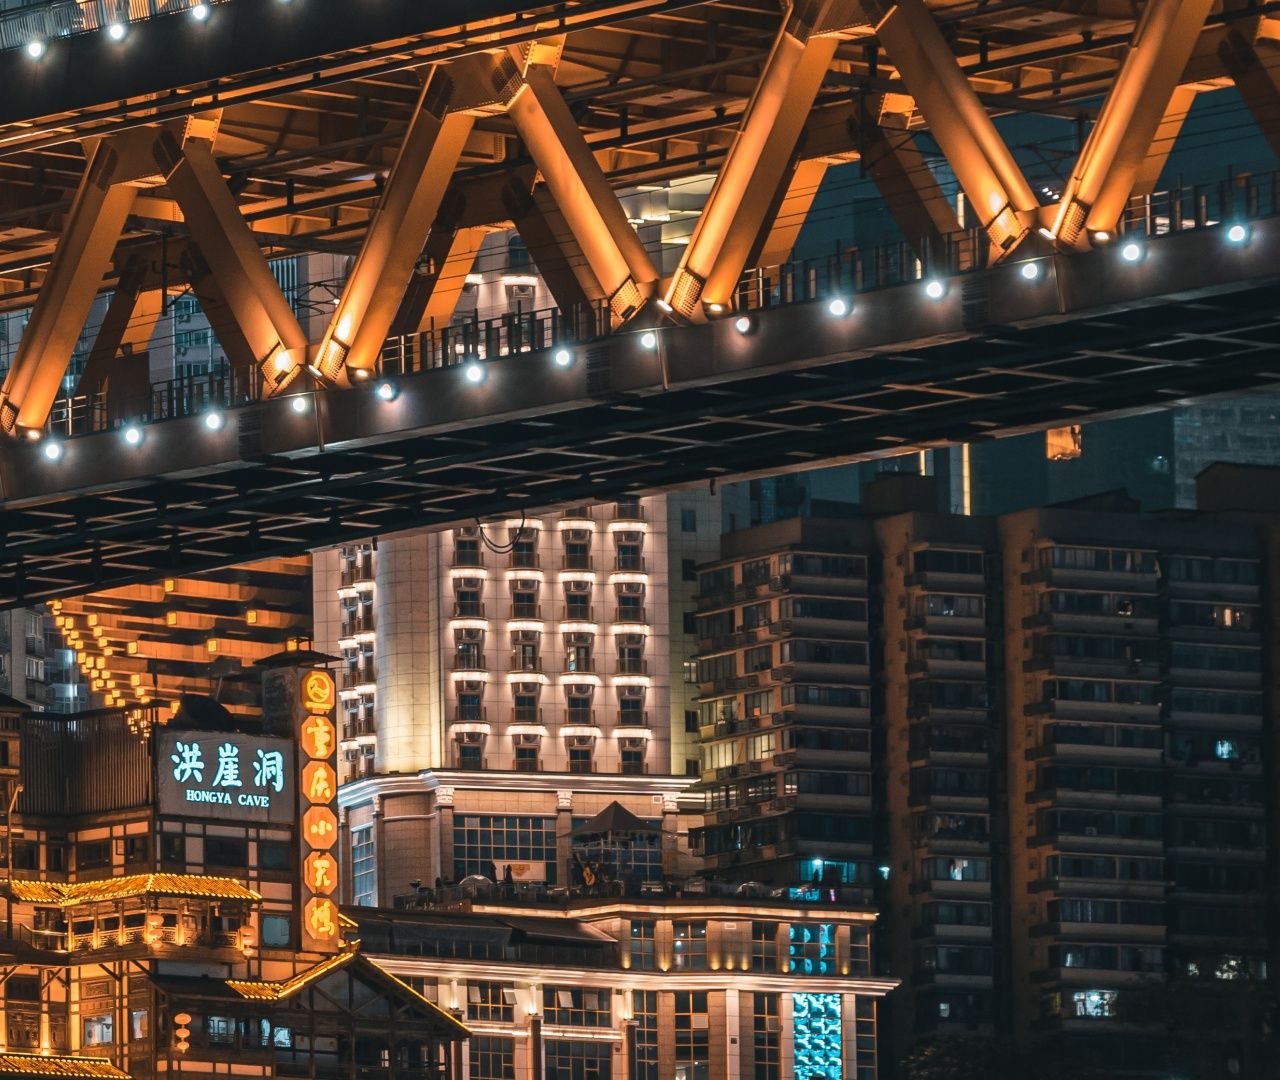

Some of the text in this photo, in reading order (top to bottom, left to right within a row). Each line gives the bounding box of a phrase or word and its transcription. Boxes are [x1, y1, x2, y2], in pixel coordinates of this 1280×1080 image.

[171, 741, 284, 792] 洪崖洞
[186, 789, 270, 808] HONGYA CAVE
